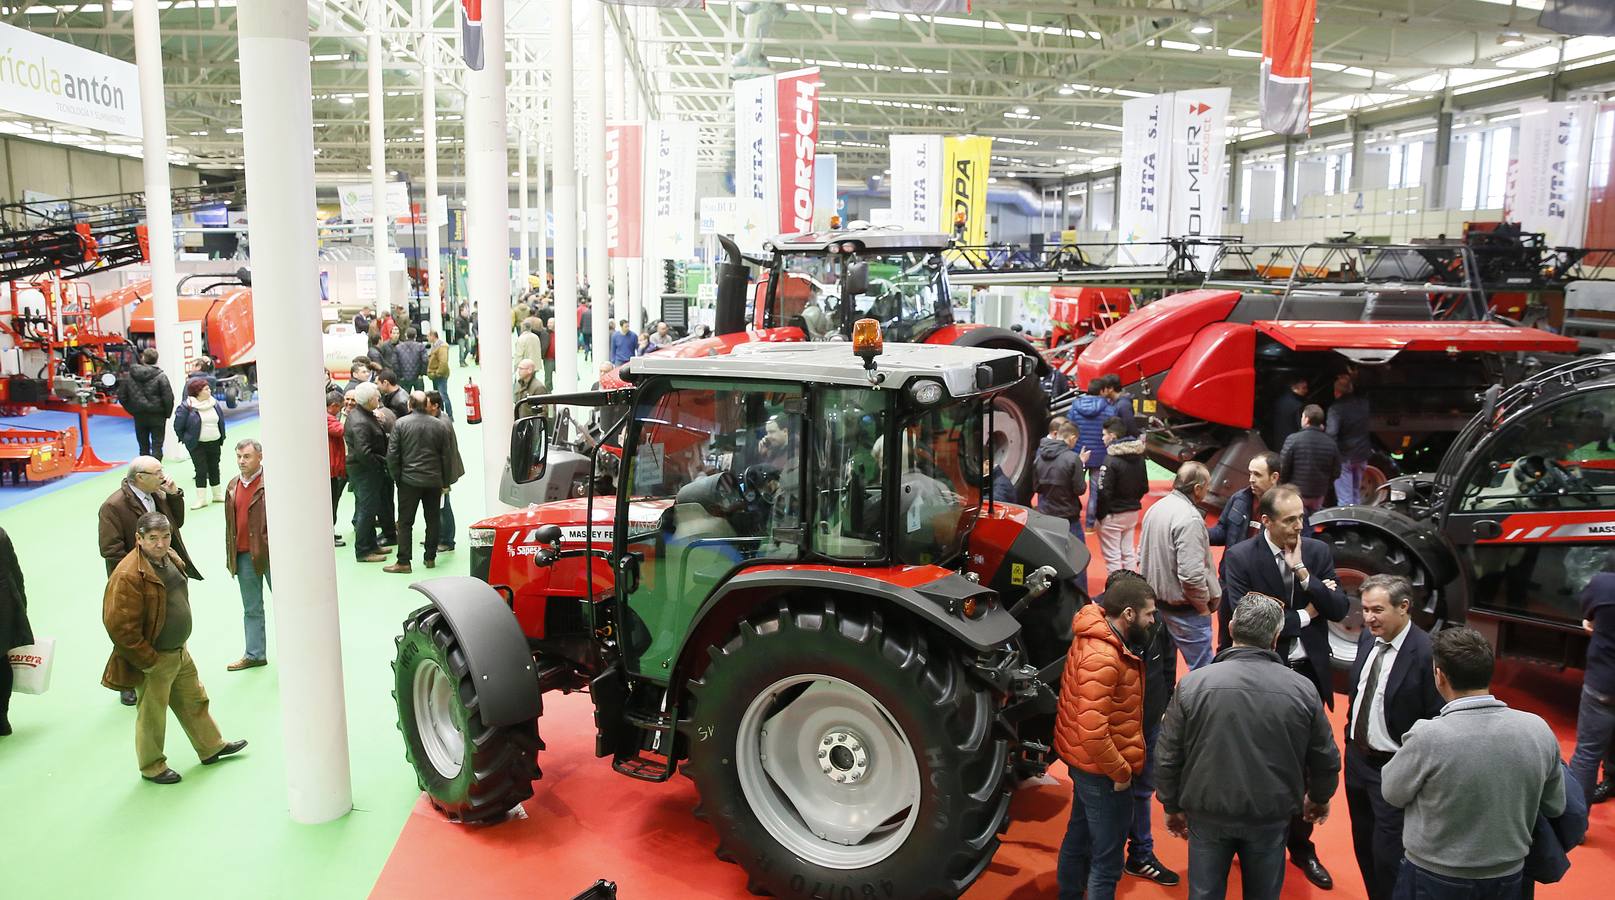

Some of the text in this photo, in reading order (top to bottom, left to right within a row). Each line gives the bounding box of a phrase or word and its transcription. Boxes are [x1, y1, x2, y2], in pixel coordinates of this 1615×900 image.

[752, 136, 764, 200] PITA
[1140, 105, 1159, 213] PITA S.L.
[913, 178, 925, 222] PITA
[1547, 160, 1567, 219] PITA
[569, 530, 603, 539] MASEY
